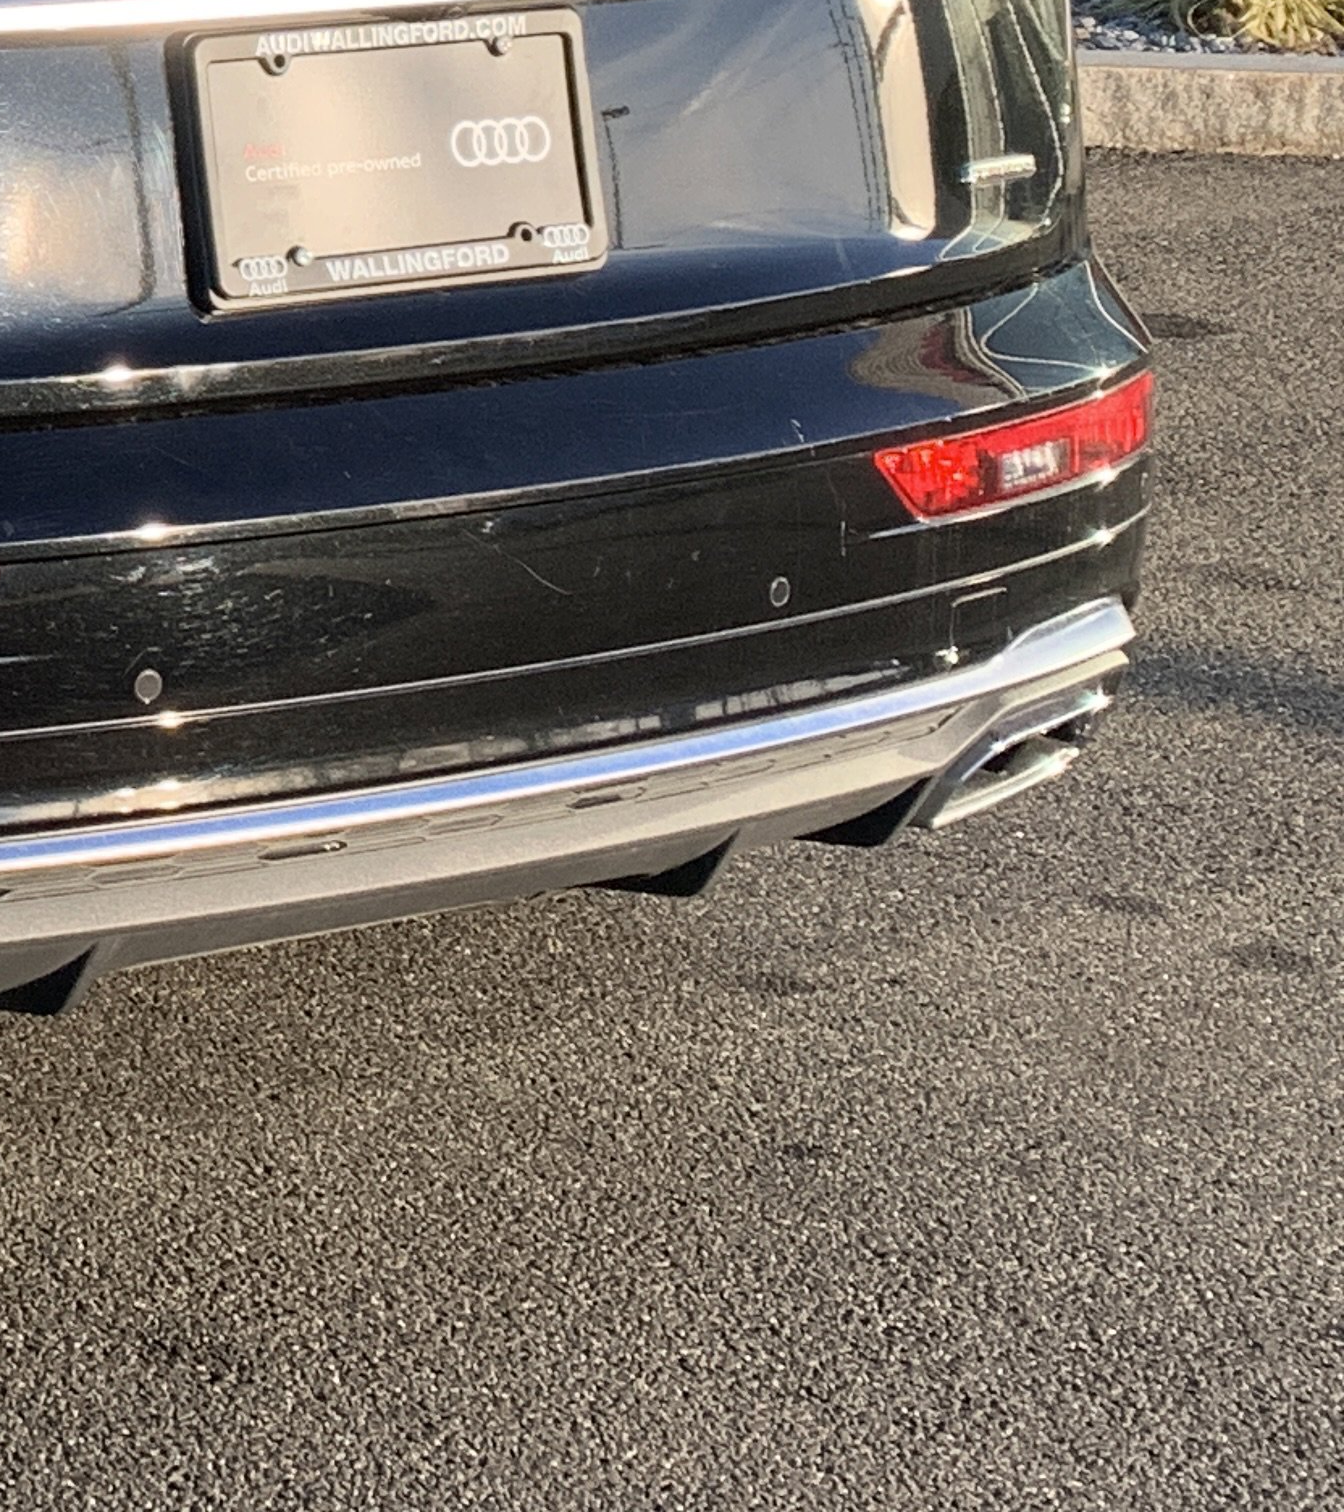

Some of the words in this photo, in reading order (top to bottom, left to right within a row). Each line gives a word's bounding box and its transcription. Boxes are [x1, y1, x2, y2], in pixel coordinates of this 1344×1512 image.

[255, 14, 528, 58] AUDIWALLINGFORD.COM
[245, 161, 322, 183] Certified
[326, 152, 422, 179] pre-owned
[325, 243, 511, 283] WALLINGFORD
[551, 246, 590, 265] Audi
[248, 278, 289, 297] Audi
